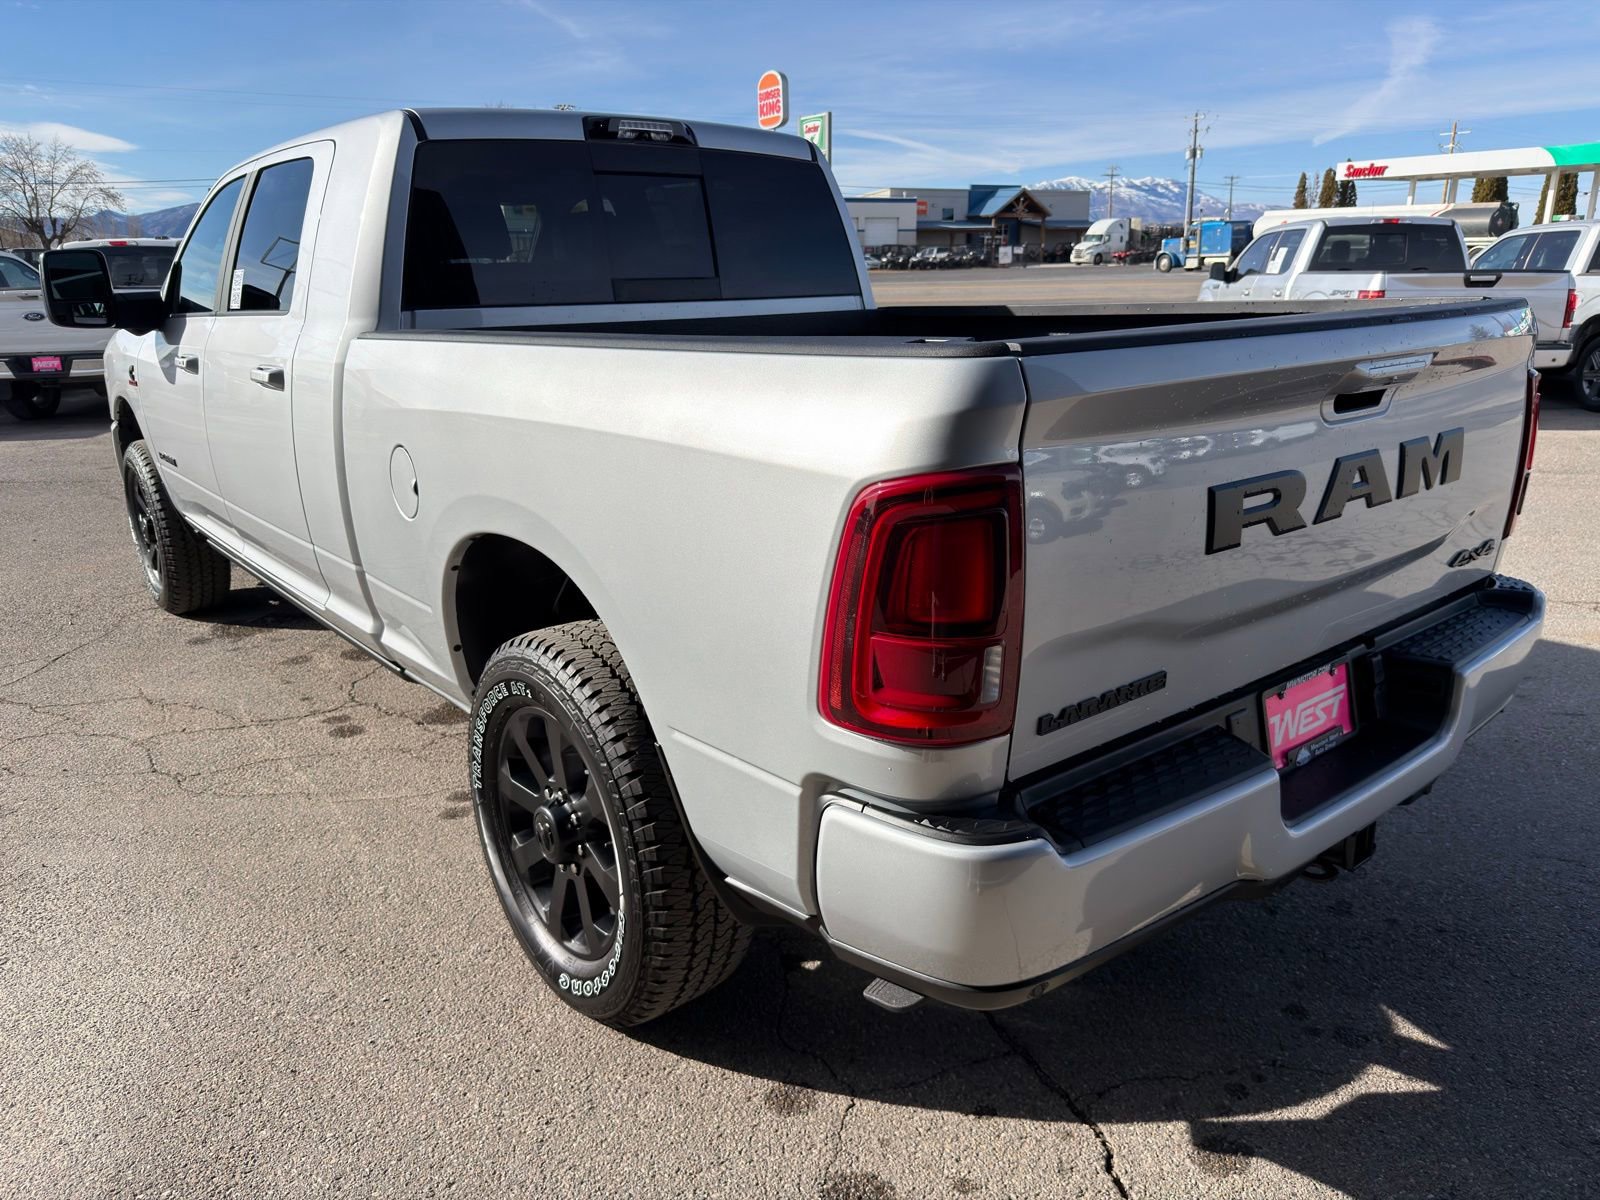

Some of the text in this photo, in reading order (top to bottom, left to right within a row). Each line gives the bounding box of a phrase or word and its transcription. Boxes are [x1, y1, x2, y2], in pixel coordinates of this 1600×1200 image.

[759, 88, 781, 102] BURGER
[759, 99, 782, 118] KING
[1344, 163, 1389, 178] Sinclair
[1204, 427, 1465, 555] RAM
[472, 682, 509, 789] TRANSFORCE
[1036, 670, 1167, 736] LARAMIE
[1269, 683, 1346, 748] WEST
